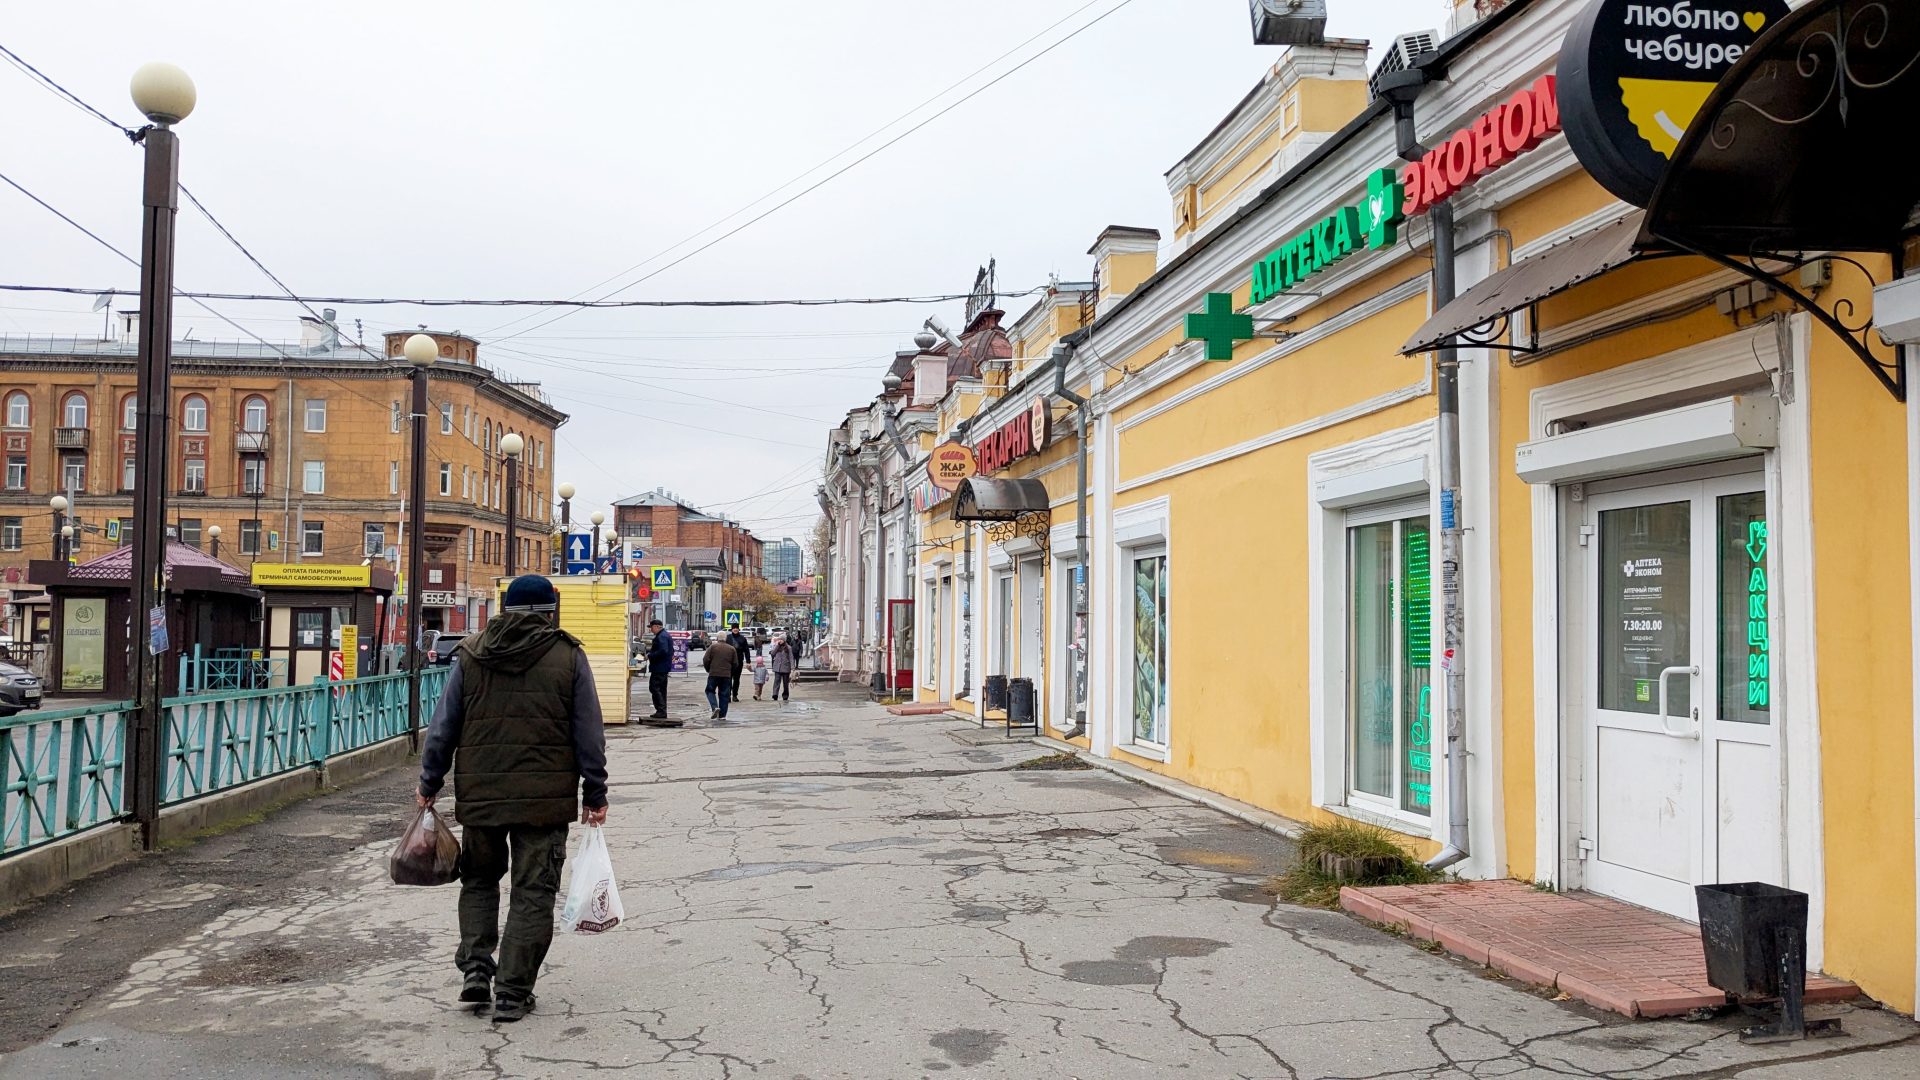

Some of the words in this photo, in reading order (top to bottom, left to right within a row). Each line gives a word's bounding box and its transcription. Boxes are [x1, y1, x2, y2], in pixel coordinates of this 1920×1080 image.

[1624, 1, 1740, 31] люблю
[1625, 34, 1750, 70] чебуре
[1250, 206, 1360, 305] АПТЕКА
[1402, 74, 1560, 216] ЭКОНОМ
[977, 410, 1029, 474] ПЕКАРНЯ
[940, 463, 966, 472] ЖАР
[1634, 557, 1662, 567] АПТЕКА
[1634, 568, 1662, 577] ЭКОНОМ
[1623, 620, 1662, 631] 7.30:20.00
[1748, 567, 1769, 706] АКЦИИ
